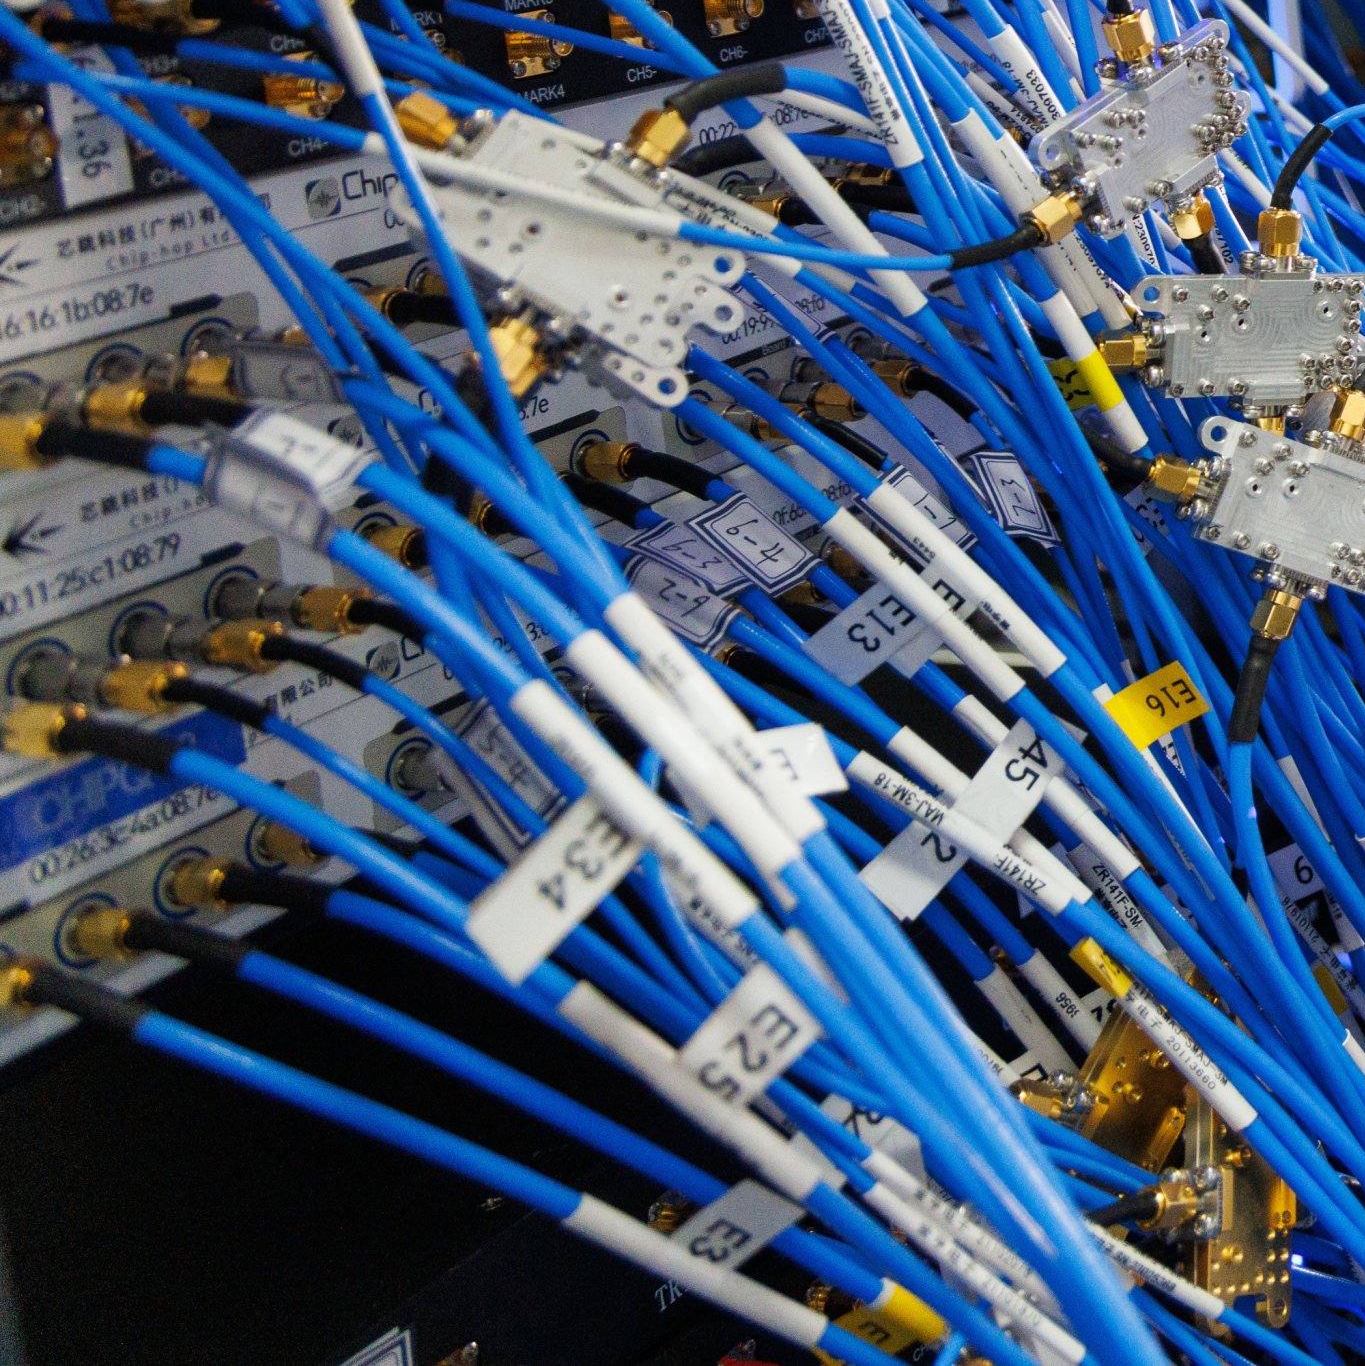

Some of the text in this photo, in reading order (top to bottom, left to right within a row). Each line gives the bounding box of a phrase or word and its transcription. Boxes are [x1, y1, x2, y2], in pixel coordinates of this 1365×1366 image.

[626, 67, 658, 84] CH5-
[719, 45, 749, 62] CH6-
[287, 137, 329, 156] CH4-
[726, 518, 785, 567] 6-4
[845, 591, 918, 655] E13
[1145, 677, 1198, 720] E16
[699, 1001, 799, 1103] E25
[688, 1217, 752, 1264] E3
